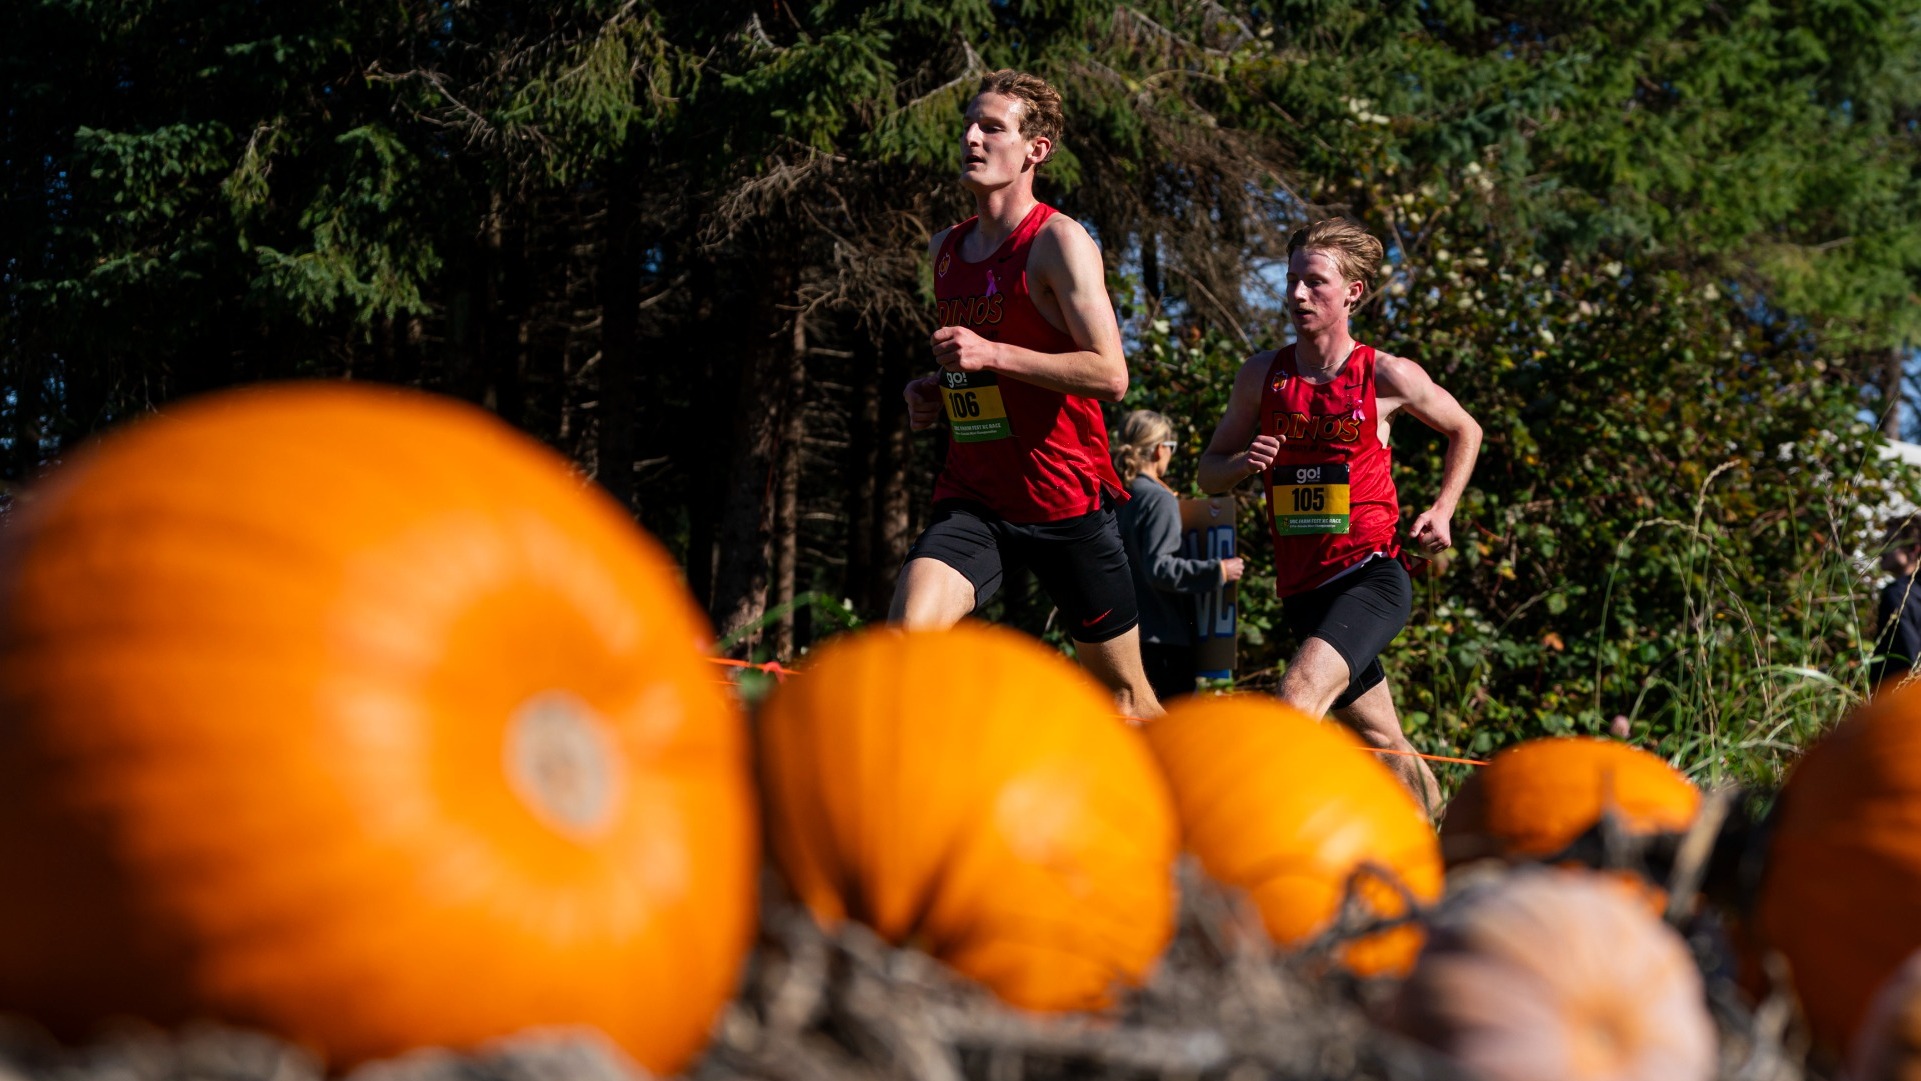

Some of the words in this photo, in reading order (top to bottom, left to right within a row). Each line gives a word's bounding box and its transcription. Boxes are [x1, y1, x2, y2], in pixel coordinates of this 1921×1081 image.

[937, 293, 1003, 327] DINOS
[947, 372, 967, 388] go!
[949, 392, 980, 418] 106
[1273, 412, 1361, 442] DINOS
[1296, 466, 1320, 484] go!
[1292, 487, 1325, 512] 105
